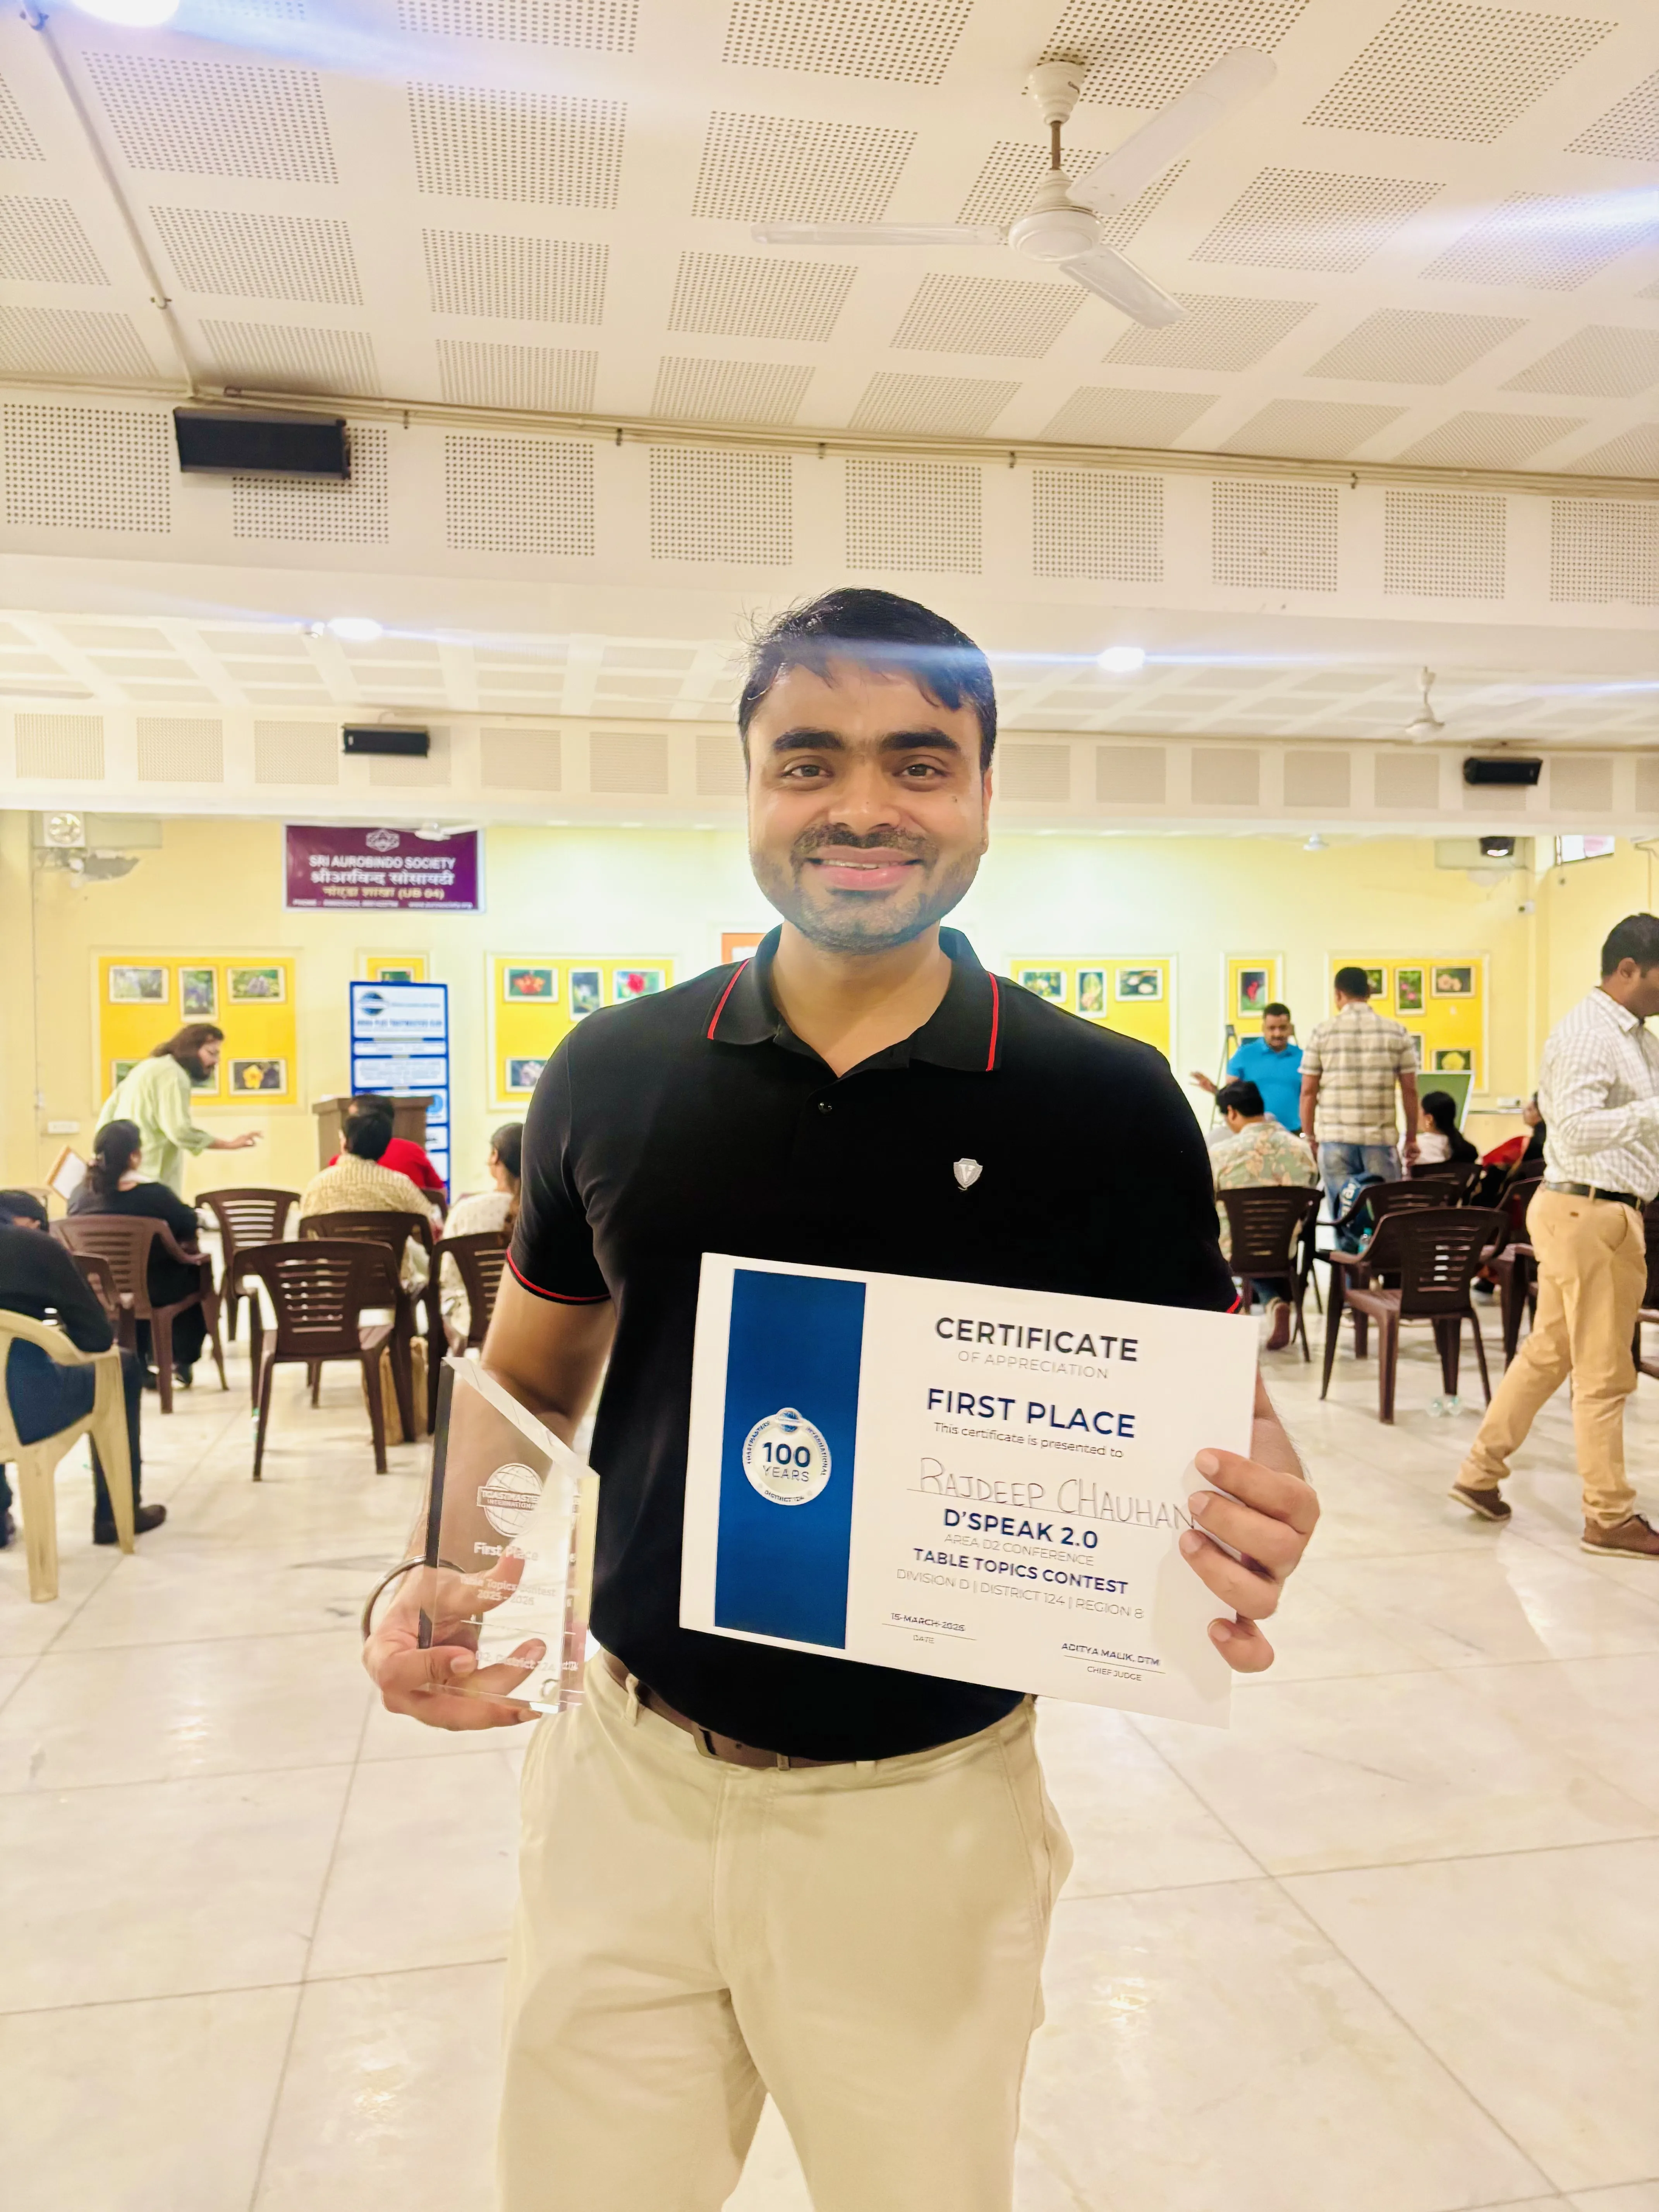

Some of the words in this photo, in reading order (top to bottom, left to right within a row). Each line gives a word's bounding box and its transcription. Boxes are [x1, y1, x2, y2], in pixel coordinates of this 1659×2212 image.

[309, 855, 330, 867] SRI
[331, 855, 403, 868] AUROBINDO
[405, 857, 456, 869] SOCIETY
[935, 1317, 1139, 1362] CERTIFICATE
[958, 1350, 980, 1363] OF
[984, 1354, 1108, 1379] APPRECIATION
[927, 1388, 1016, 1420] FIRST
[1026, 1401, 1135, 1438] PLACE
[934, 1422, 958, 1434] This
[961, 1427, 1025, 1444] certificate
[1027, 1434, 1037, 1445] is
[1041, 1438, 1106, 1455] presented
[1110, 1448, 1123, 1458] to
[762, 1442, 811, 1468] 100
[763, 1465, 809, 1482] YEARS
[482, 1491, 539, 1503] TOASTMASTE
[920, 1457, 1046, 1508] RAJDEEP
[1057, 1478, 1195, 1530] CHAUHAN
[944, 1534, 979, 1547] AREA
[983, 1539, 1001, 1551] D2
[1003, 1542, 1094, 1566] CONFERENCE
[1060, 1527, 1099, 1549] 2.0
[474, 1542, 503, 1556] First
[505, 1545, 539, 1561] Place
[913, 1547, 969, 1568] TABLE
[974, 1557, 1038, 1580] TOPICS
[1042, 1569, 1128, 1594] CONTEST
[486, 1578, 518, 1592] Topics
[520, 1584, 557, 1597] Contest
[896, 1568, 956, 1587] DIVISION
[959, 1579, 969, 1589] D
[980, 1582, 1040, 1601] DISTRICT
[1044, 1593, 1065, 1605] 124
[1075, 1598, 1130, 1618] REGION
[1134, 1608, 1144, 1619] 8
[913, 1635, 934, 1643] DATE
[1061, 1643, 1098, 1655] ADITYA
[1101, 1649, 1135, 1662] MALIK,
[1137, 1656, 1161, 1666] DTM
[1087, 1666, 1112, 1675] CHIEF
[1113, 1670, 1142, 1681] JUDGE
